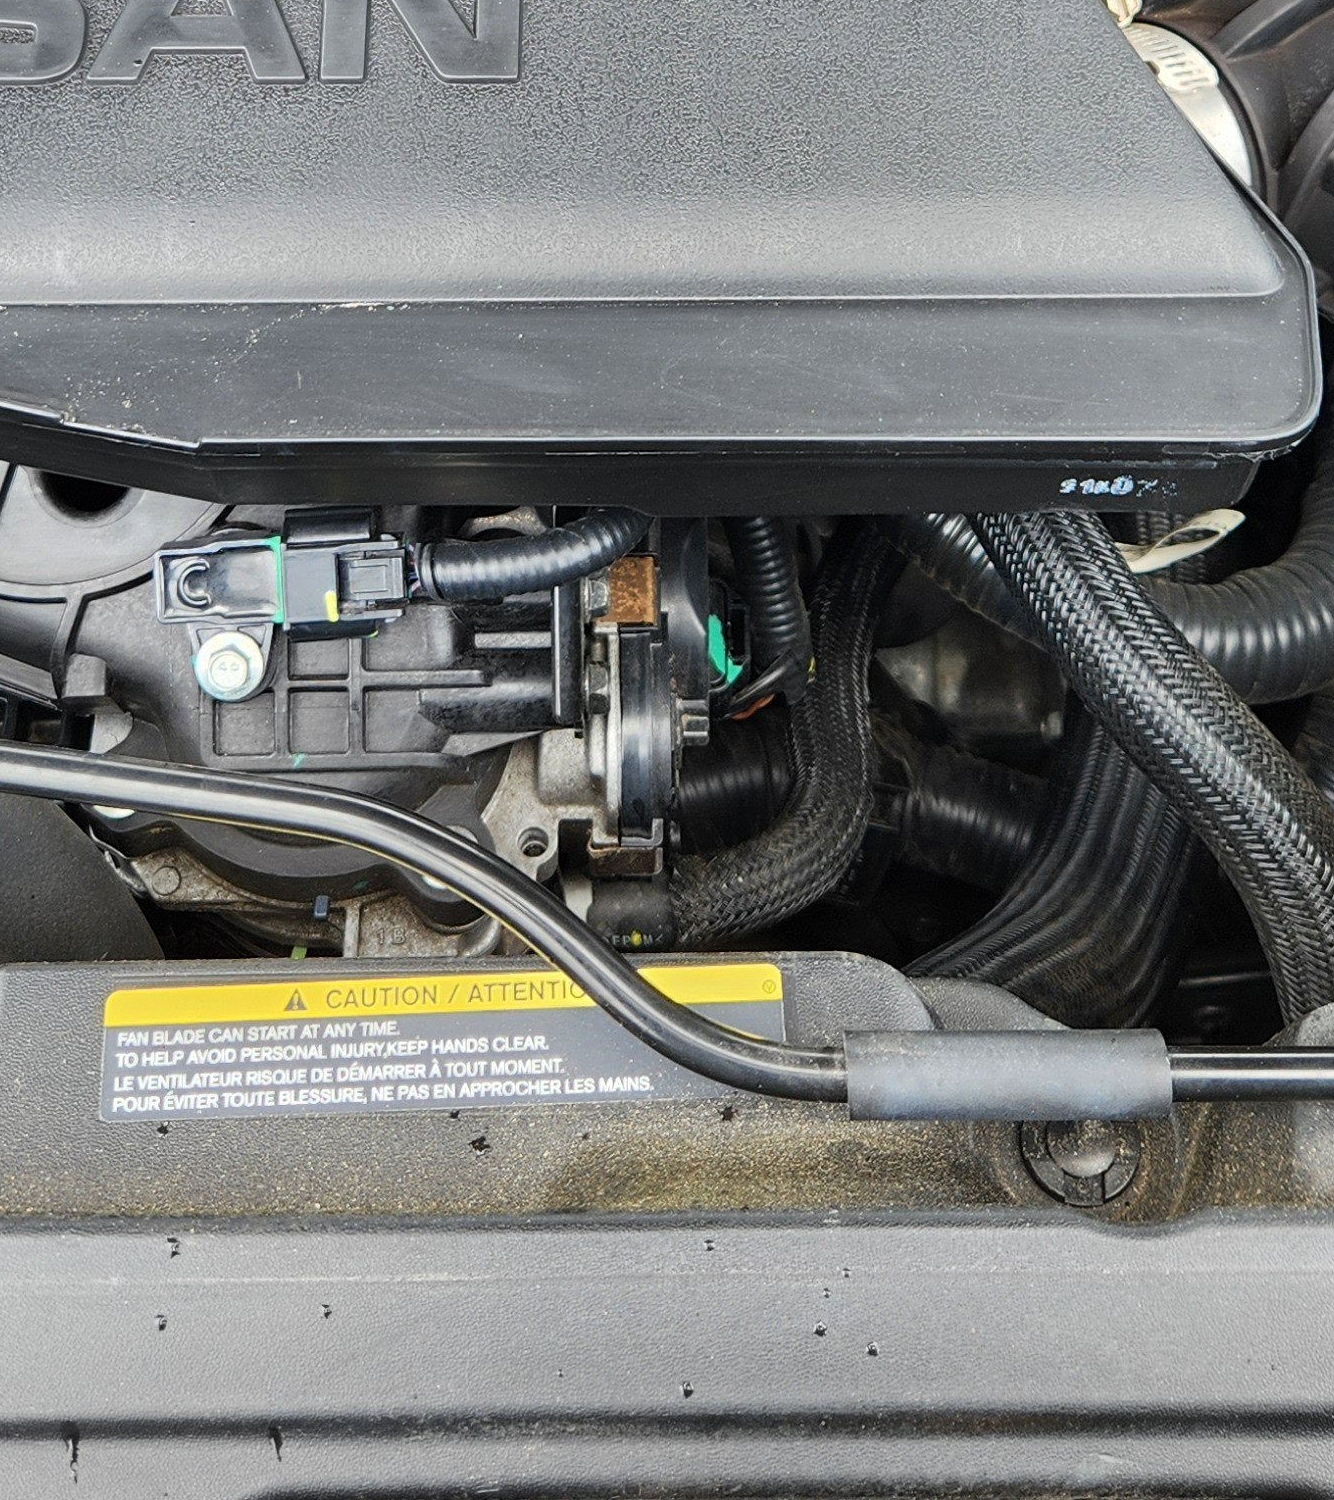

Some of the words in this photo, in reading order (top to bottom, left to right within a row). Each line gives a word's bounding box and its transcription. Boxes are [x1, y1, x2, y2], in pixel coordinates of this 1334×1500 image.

[326, 984, 438, 1009] CAUTION
[117, 1030, 149, 1047] FAN
[152, 1028, 206, 1046] BLADE
[208, 1026, 244, 1043] CAN
[247, 1024, 298, 1041] START
[300, 1023, 320, 1039] AT
[323, 1022, 357, 1038] ANY
[360, 1020, 401, 1037] TIME.
[116, 1051, 139, 1068] TO
[142, 1050, 185, 1067] HELP
[185, 1047, 237, 1065] AVOID
[240, 1044, 328, 1062] PERSONAL
[432, 1037, 489, 1056] HANDS
[492, 1034, 550, 1051] CLEAR.
[114, 1075, 135, 1092] LE
[137, 1070, 243, 1091] VENTILATEUR
[245, 1067, 309, 1085] RISQUE
[310, 1066, 334, 1084] DE
[336, 1061, 427, 1082] DÉMARRER
[428, 1058, 443, 1079] À
[444, 1061, 488, 1078] TOUT
[490, 1058, 566, 1076] MOMENT.
[113, 1096, 161, 1113] POUR
[163, 1090, 219, 1111] ÉVITER
[221, 1090, 276, 1108] TOUTE
[278, 1086, 369, 1106] BLESSURE,
[371, 1084, 395, 1102] NE
[397, 1083, 430, 1100] PAS
[433, 1081, 457, 1099] EN
[460, 1078, 562, 1098] APPROCHER
[564, 1077, 596, 1094] LES
[598, 1075, 655, 1093] MAINS.
